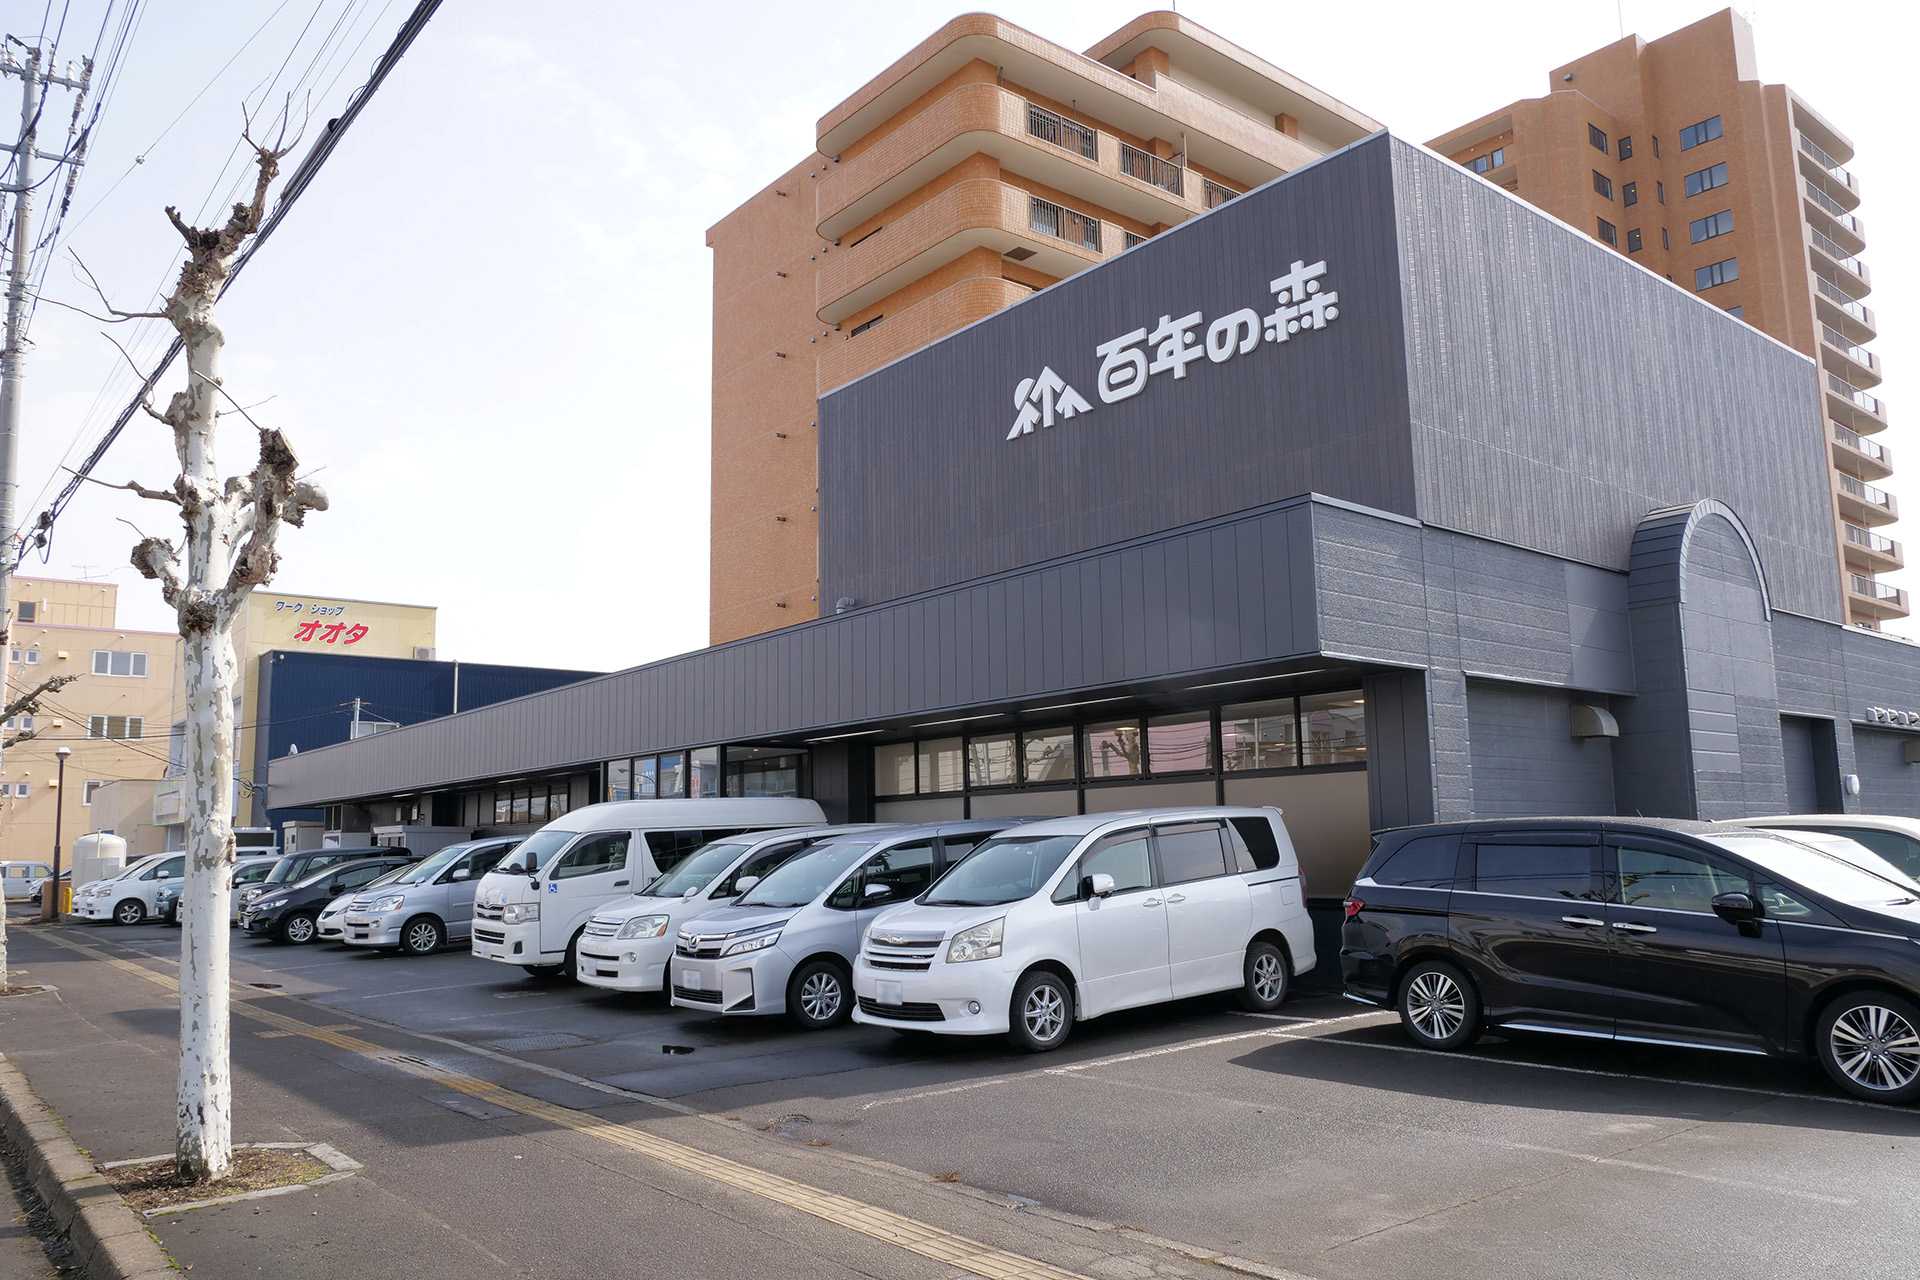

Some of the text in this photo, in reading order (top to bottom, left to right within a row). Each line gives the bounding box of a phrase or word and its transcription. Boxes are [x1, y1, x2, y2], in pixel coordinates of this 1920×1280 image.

[1096, 260, 1340, 404] 百年の森
[275, 601, 345, 616] ワーク ショップ
[294, 620, 369, 645] オオタ
